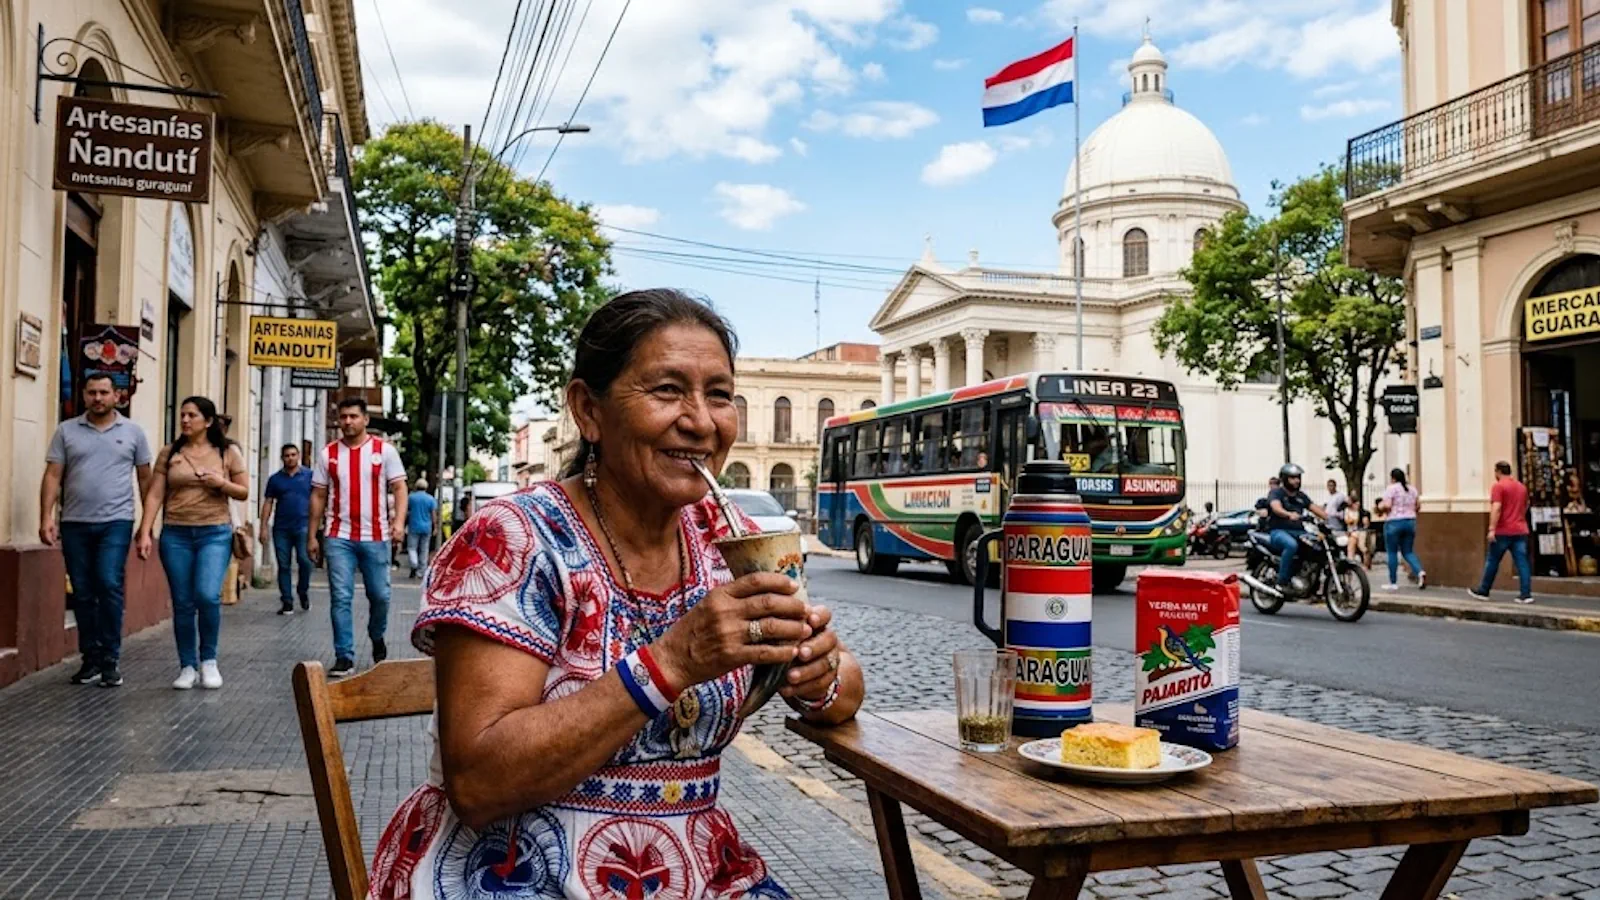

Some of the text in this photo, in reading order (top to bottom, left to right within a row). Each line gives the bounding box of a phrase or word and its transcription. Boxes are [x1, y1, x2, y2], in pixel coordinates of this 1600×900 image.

[66, 106, 203, 140] Artesanías
[68, 130, 200, 175] Ñandutí
[254, 336, 333, 359] ÑANDUTÍ
[1058, 379, 1159, 399] LINEA 23
[1181, 602, 1209, 613] MATE
[1016, 657, 1091, 684] ARAGUA
[1142, 671, 1211, 705] PAJARITO
